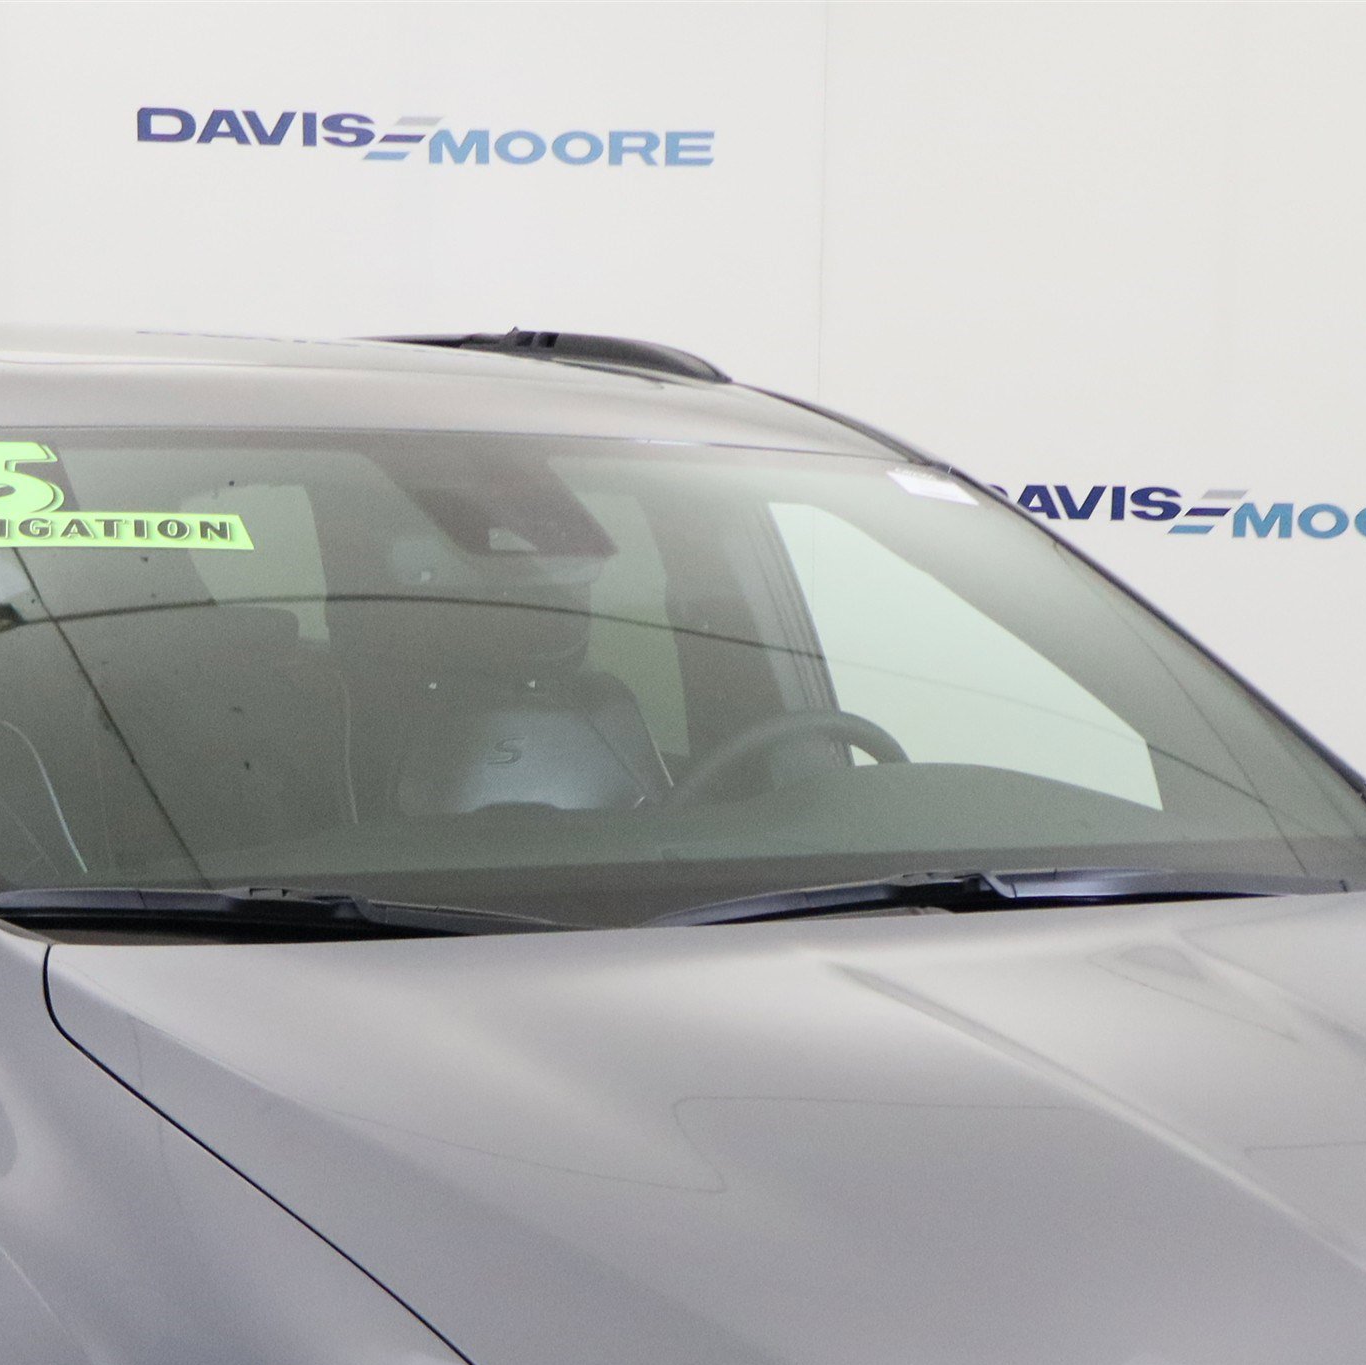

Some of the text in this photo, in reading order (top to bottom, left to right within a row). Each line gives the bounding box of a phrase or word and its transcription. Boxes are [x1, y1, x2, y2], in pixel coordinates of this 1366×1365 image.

[137, 107, 716, 167] DAVIS MOORE
[989, 484, 1182, 522] AVIS
